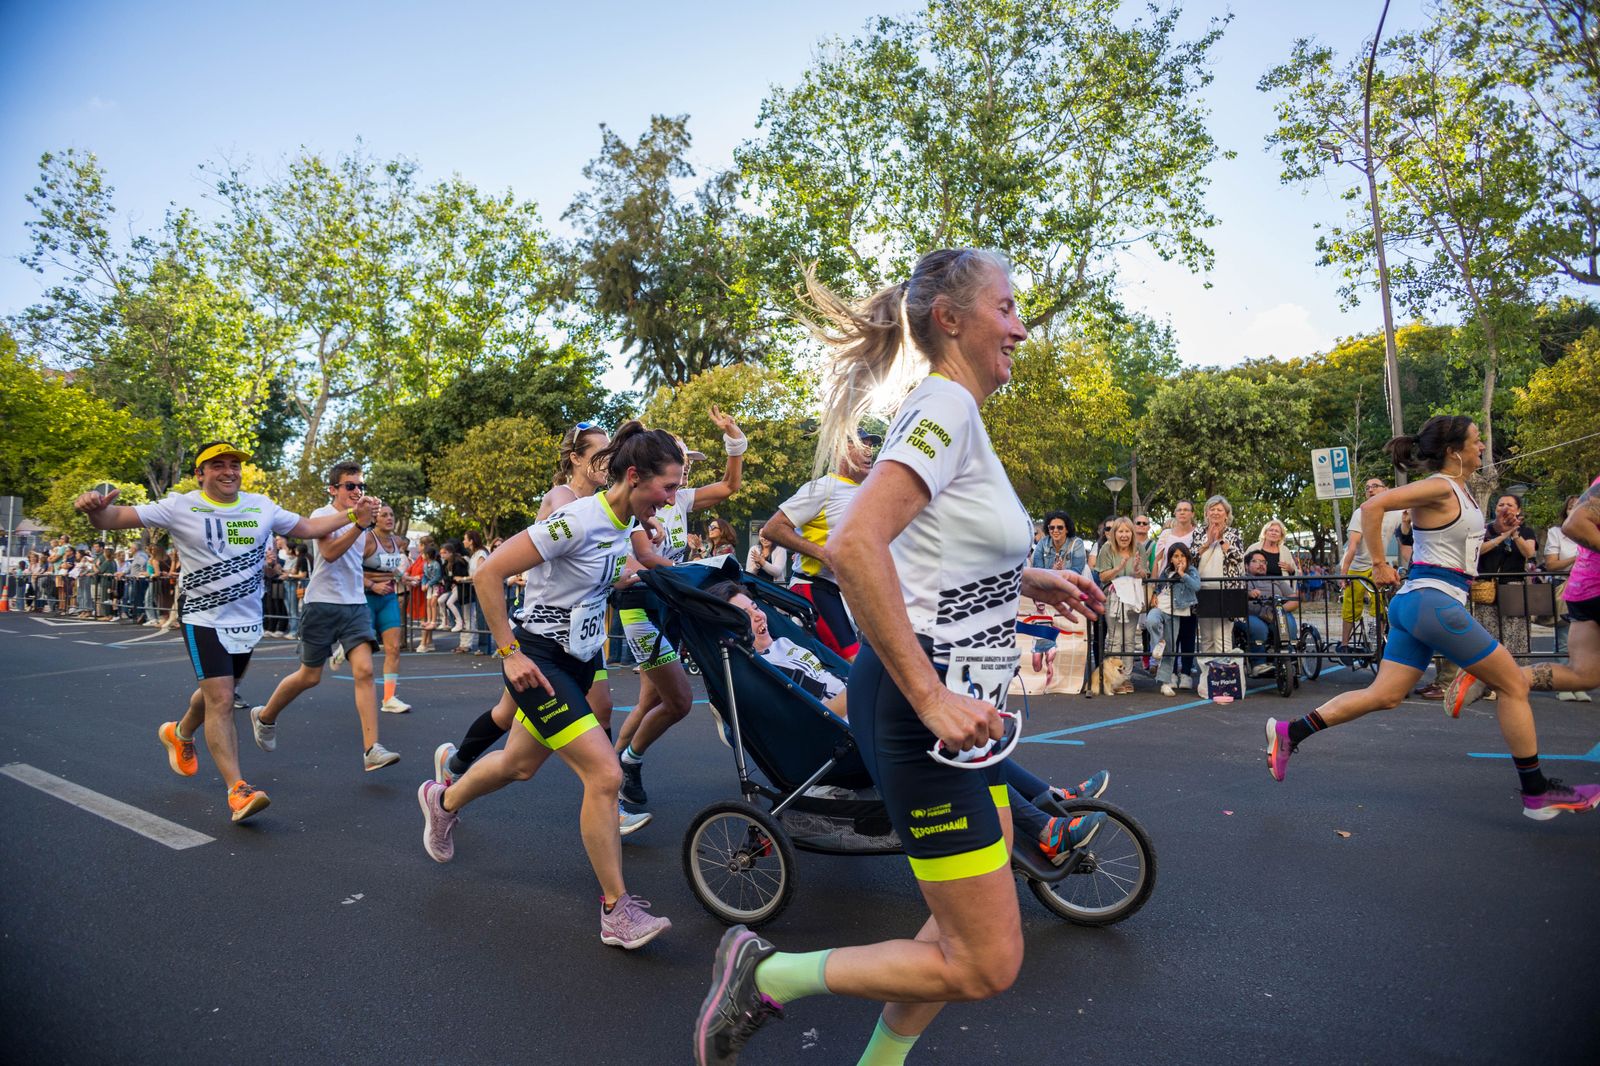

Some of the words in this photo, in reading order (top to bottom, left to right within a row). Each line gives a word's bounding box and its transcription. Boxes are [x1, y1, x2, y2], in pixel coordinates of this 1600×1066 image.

[912, 427, 926, 438] DE
[919, 418, 952, 447] CARROS
[906, 435, 936, 460] FUEGO
[226, 520, 259, 528] CARROS
[227, 528, 239, 536] DE
[228, 537, 255, 545] FUEGO
